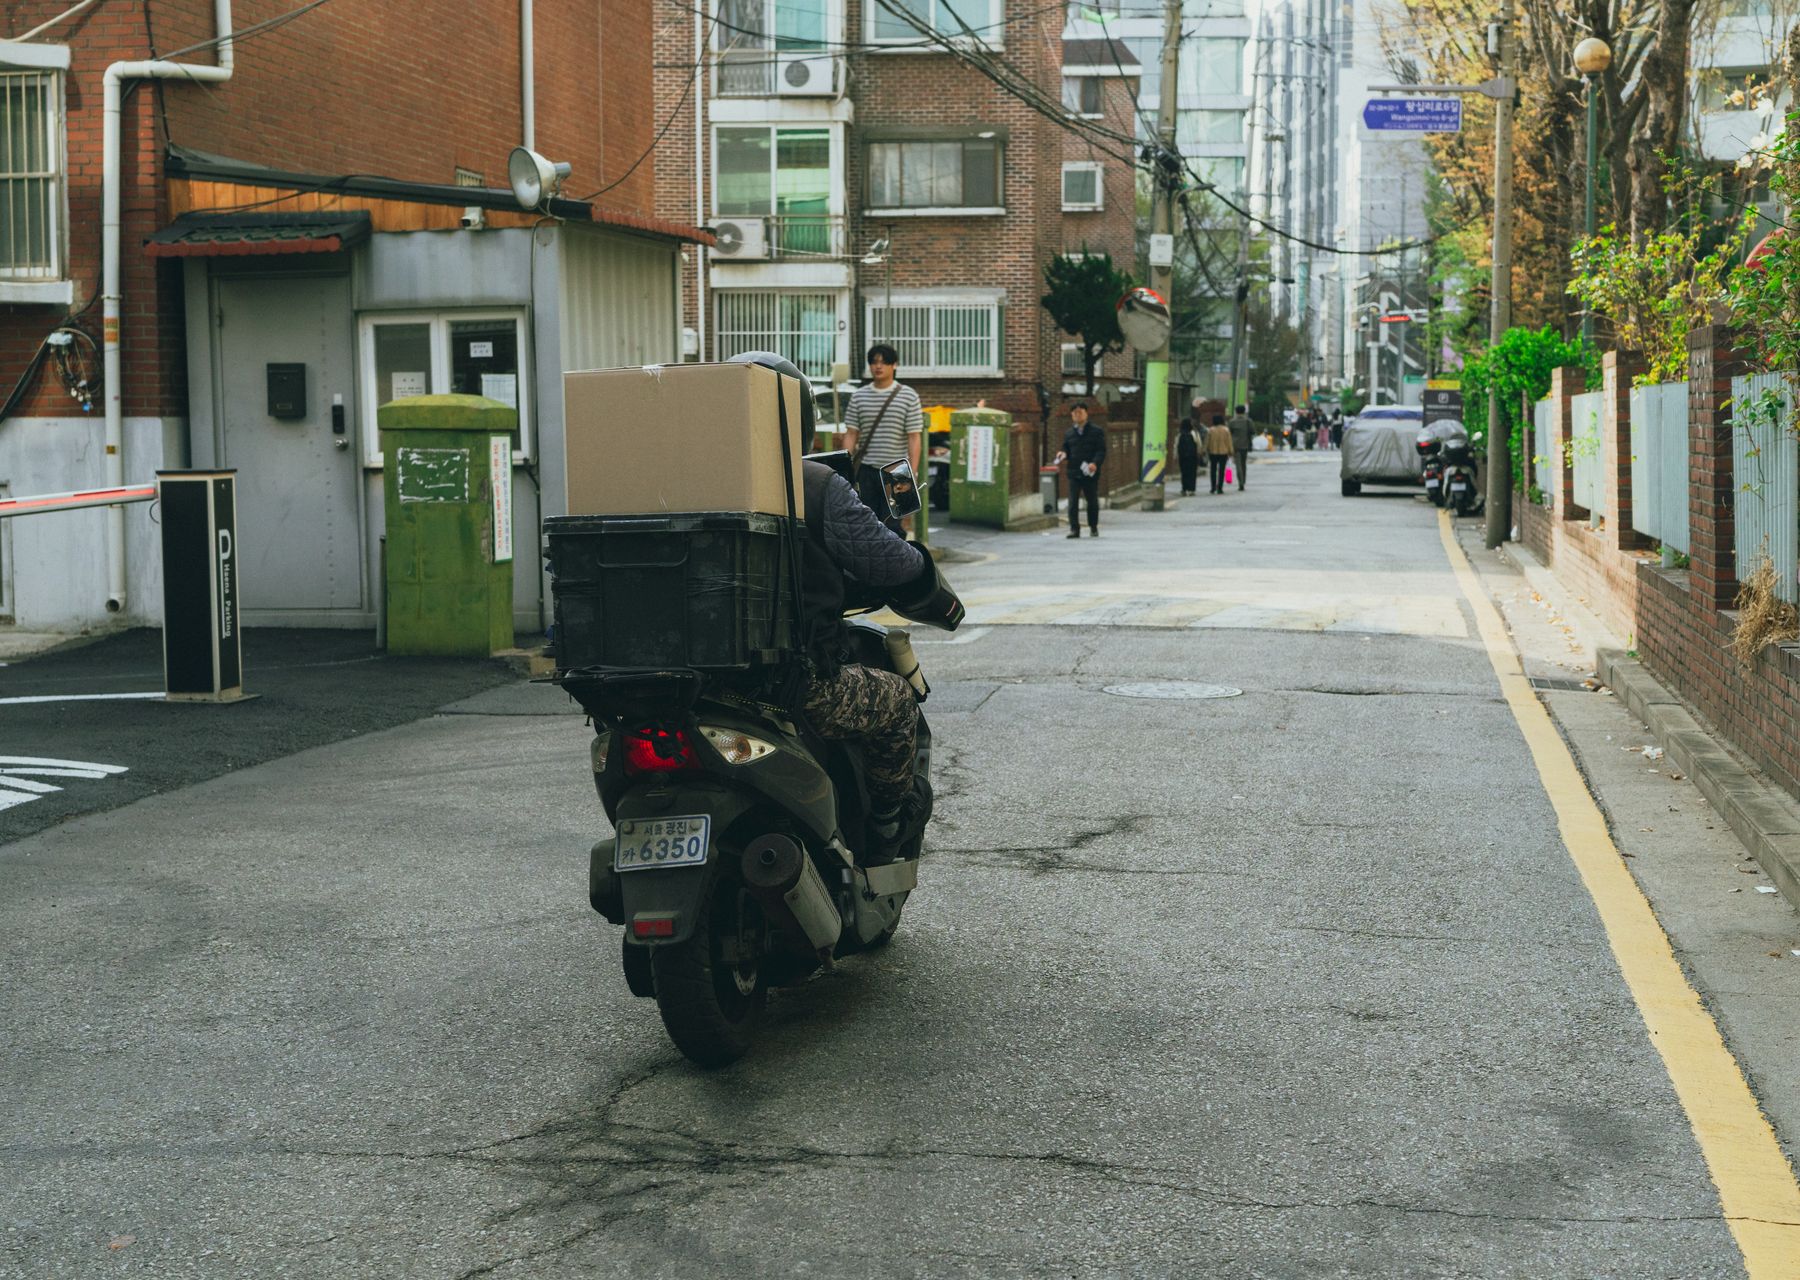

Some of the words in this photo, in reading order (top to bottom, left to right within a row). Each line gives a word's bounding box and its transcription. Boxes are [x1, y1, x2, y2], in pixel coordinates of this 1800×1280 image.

[644, 823, 663, 836] 서울
[666, 821, 687, 836] 광진
[640, 836, 701, 861] 6350
